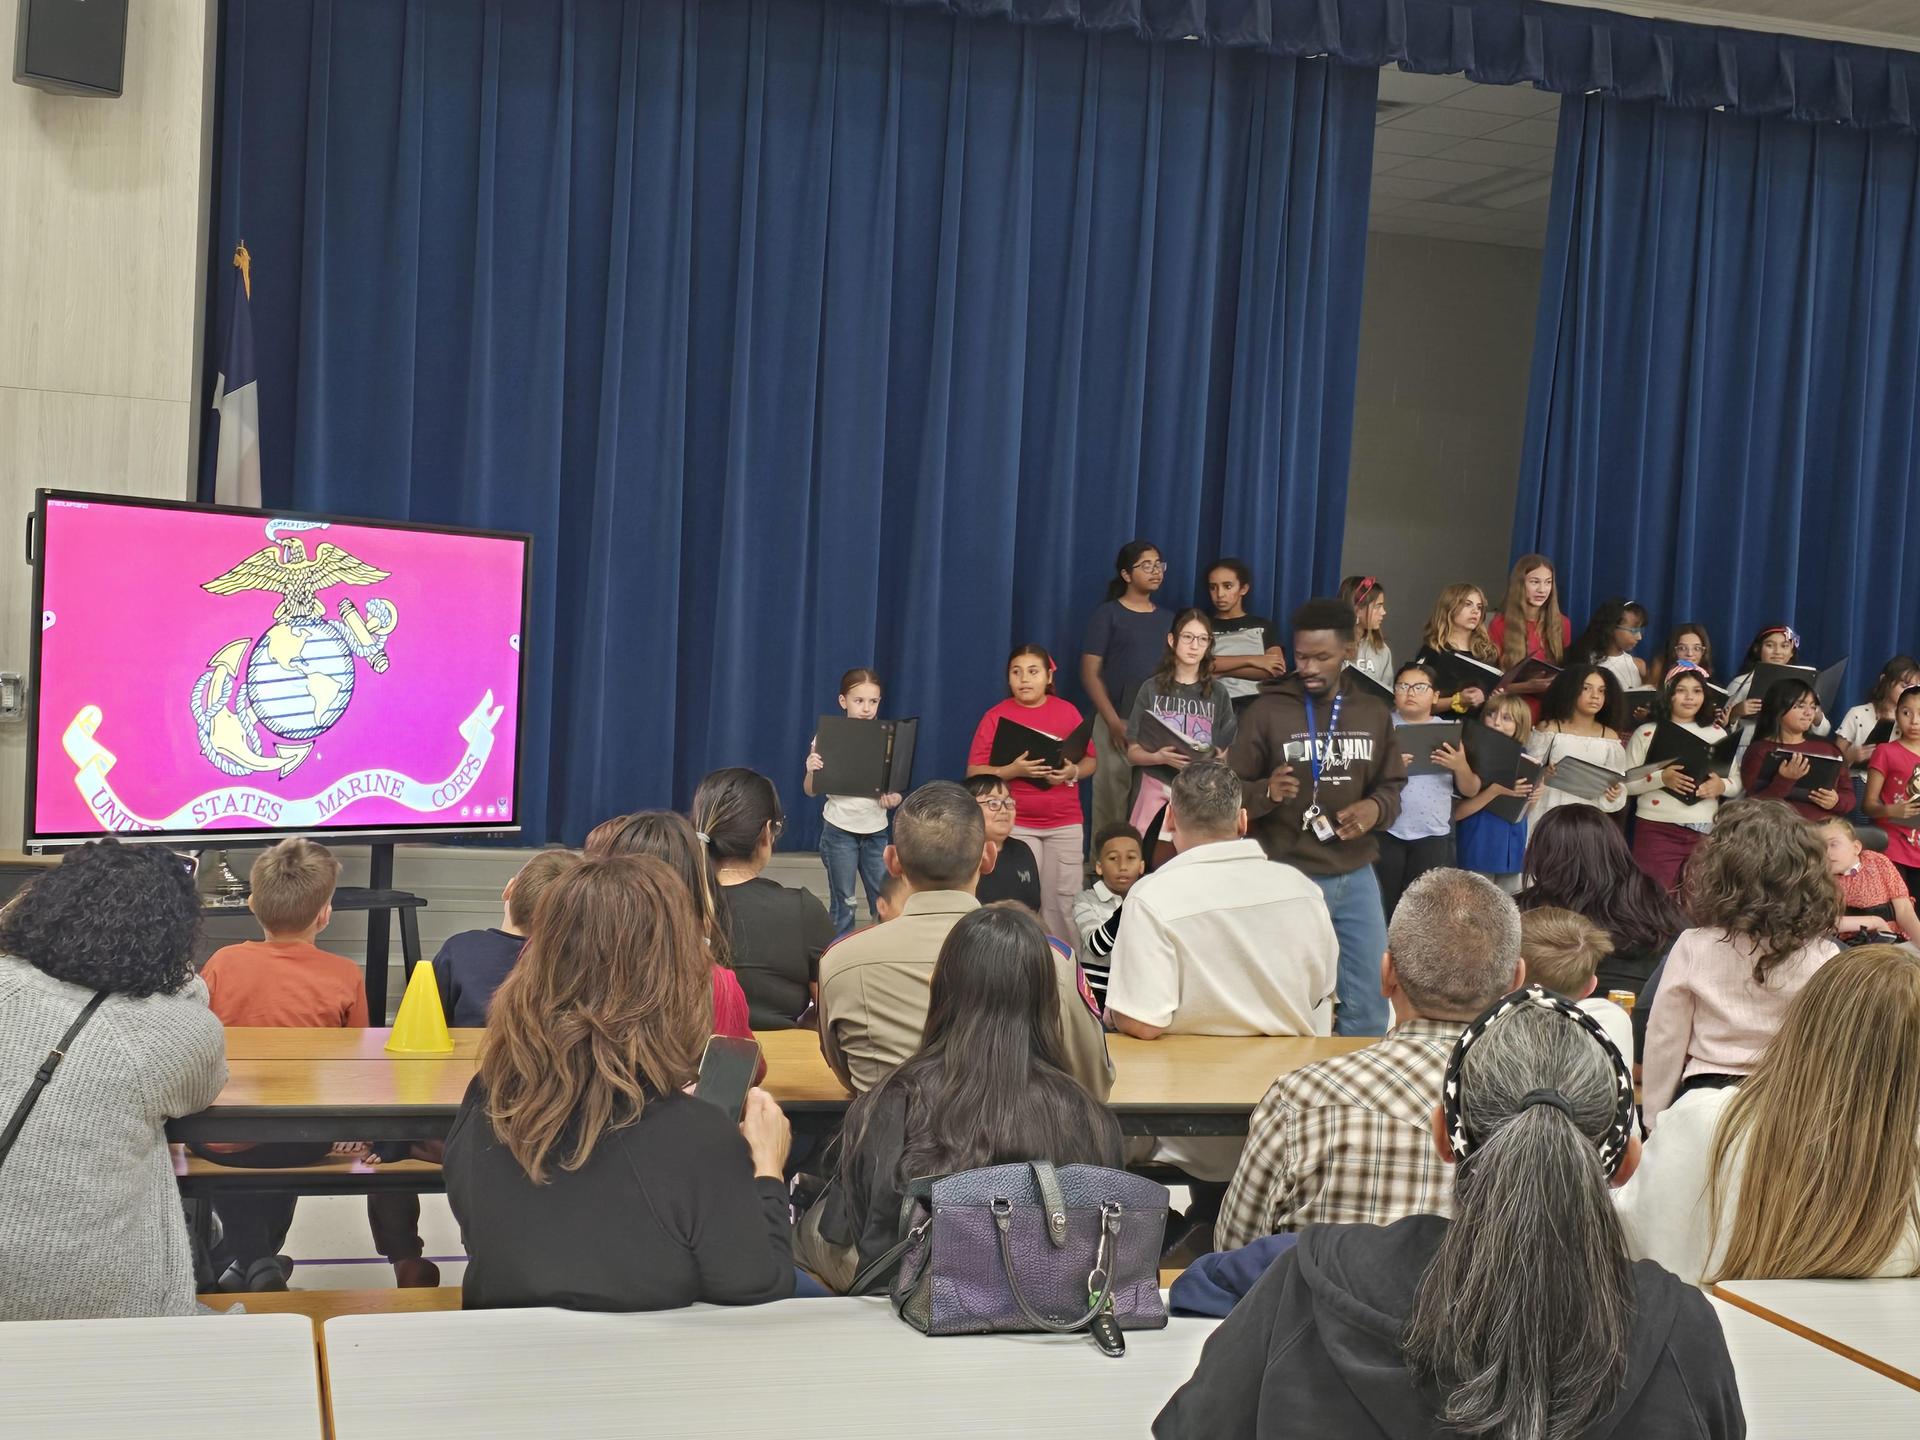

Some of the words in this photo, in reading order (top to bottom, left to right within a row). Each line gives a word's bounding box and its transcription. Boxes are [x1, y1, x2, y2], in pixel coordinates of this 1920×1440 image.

[1153, 695, 1215, 724] KUROMI
[91, 786, 165, 832] UNIT
[192, 793, 283, 825] STATES
[315, 773, 405, 818] MARINE
[432, 754, 482, 808] CORPS
